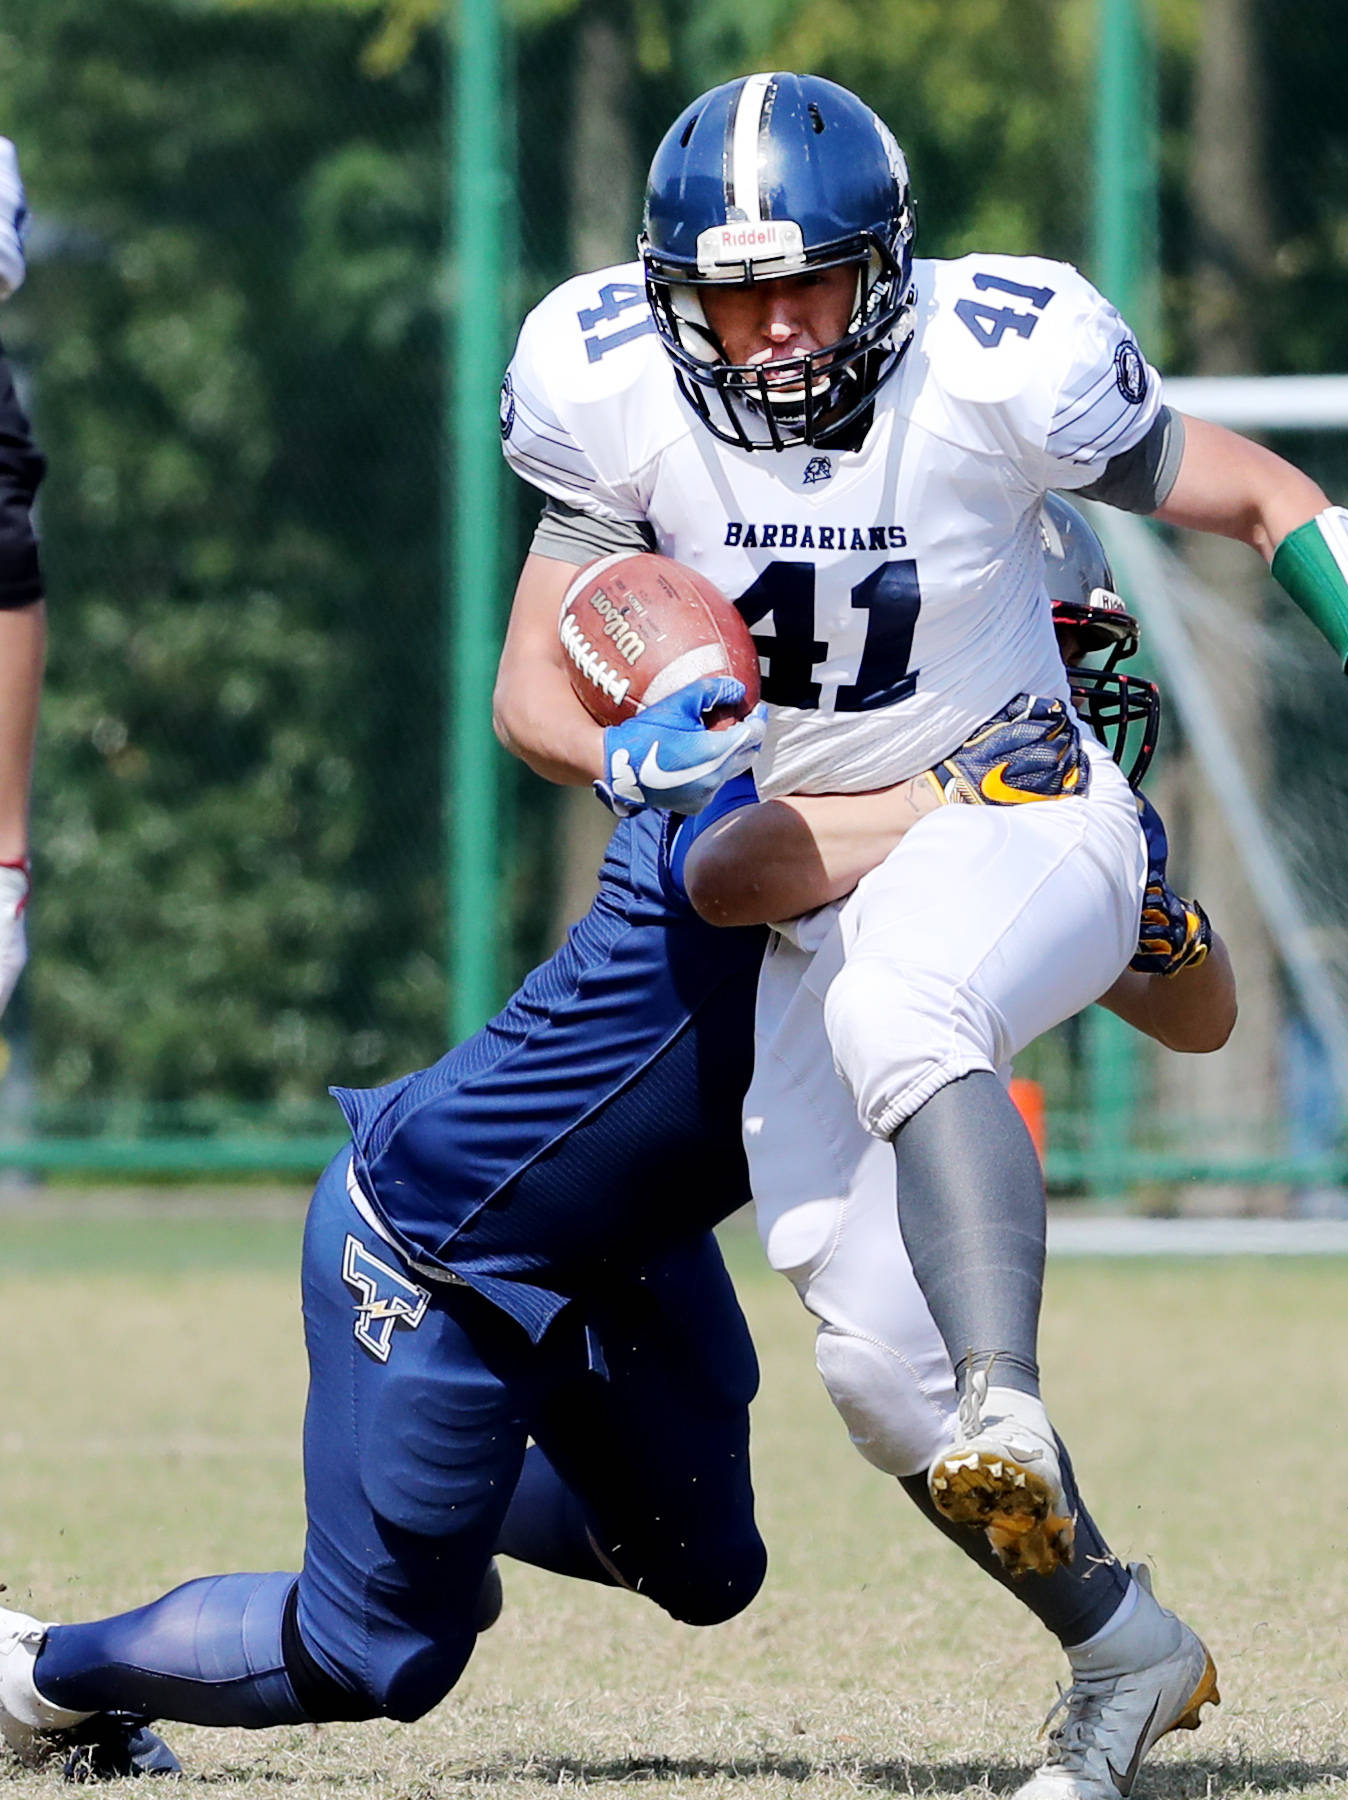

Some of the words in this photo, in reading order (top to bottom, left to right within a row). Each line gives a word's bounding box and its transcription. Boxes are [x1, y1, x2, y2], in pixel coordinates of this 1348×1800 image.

[722, 227, 776, 247] Riddell
[577, 283, 656, 364] 41
[953, 272, 1056, 349] 41
[724, 522, 907, 551] BARBARIANS
[589, 588, 646, 666] Wilson
[732, 558, 921, 713] 41
